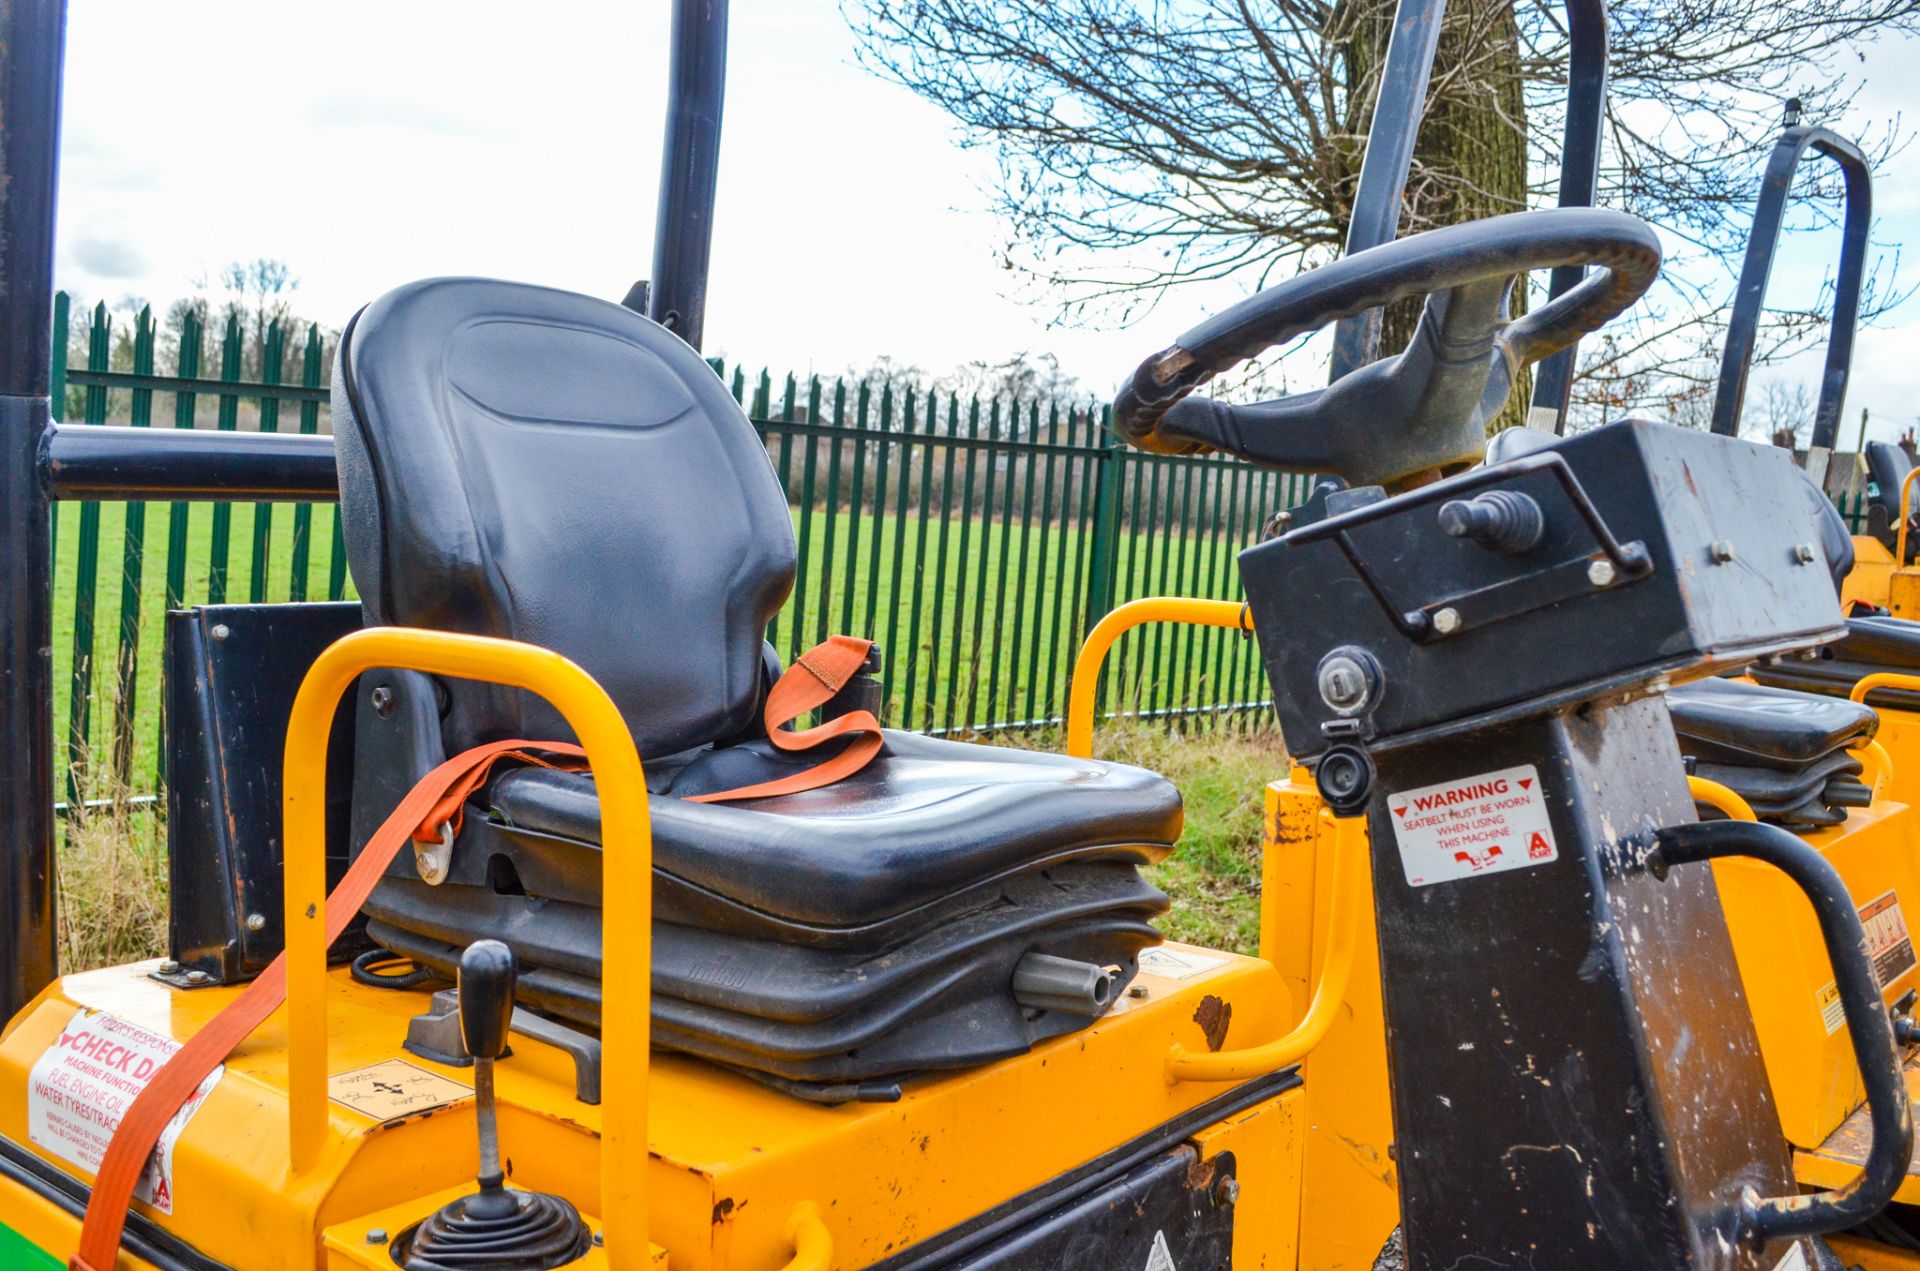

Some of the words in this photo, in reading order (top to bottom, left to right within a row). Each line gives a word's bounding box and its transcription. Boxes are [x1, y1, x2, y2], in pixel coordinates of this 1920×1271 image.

[1413, 779, 1508, 811] WARNING
[1404, 813, 1446, 831] SEATBELT
[1449, 806, 1477, 821] MUST
[1481, 803, 1492, 815] BE
[1495, 796, 1530, 812] WORN
[1436, 821, 1470, 836] WHEN
[1472, 815, 1505, 829] USING
[1438, 837, 1460, 849] THIS
[1463, 827, 1511, 844] MACHINE
[1529, 848, 1552, 860] PLANT
[1530, 831, 1549, 850] A
[71, 1031, 138, 1073] CHECK
[48, 1068, 71, 1089] FUEL
[69, 1078, 106, 1106] ENGINE
[106, 1096, 124, 1113] OIL
[64, 1055, 103, 1080] MACHINE
[101, 1071, 140, 1096] FUNCTIO
[35, 1081, 63, 1105] WATER
[65, 1095, 120, 1133] TYRES/TRAC
